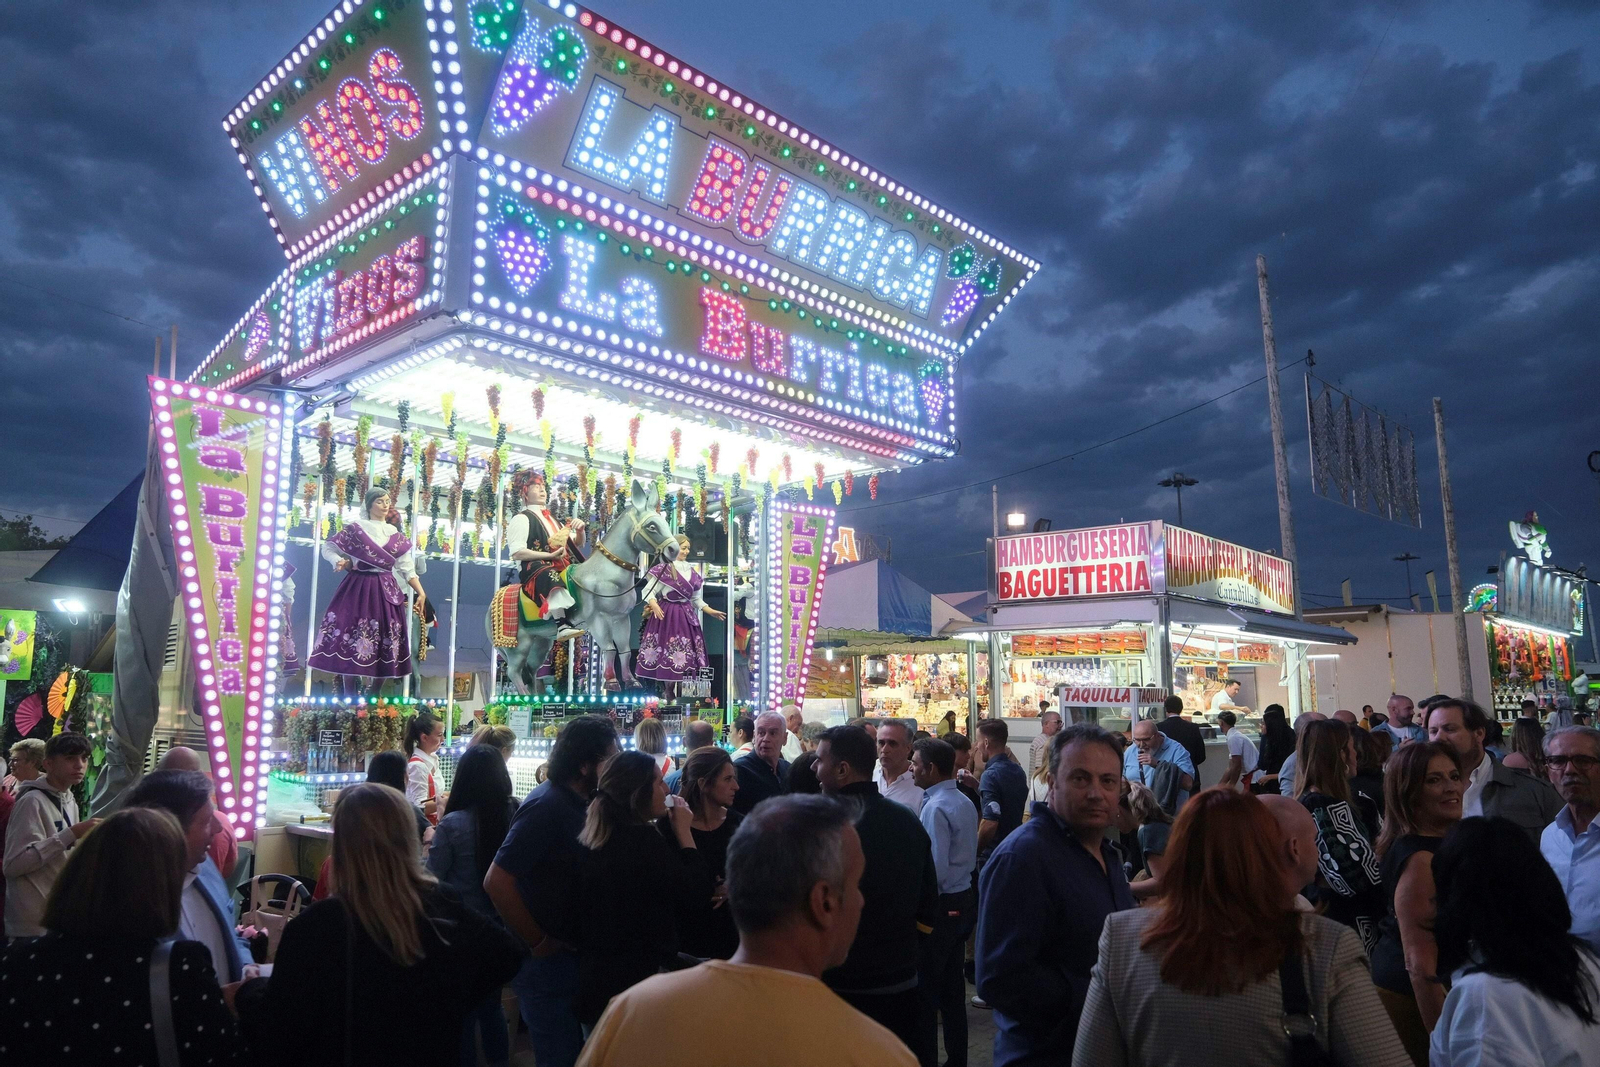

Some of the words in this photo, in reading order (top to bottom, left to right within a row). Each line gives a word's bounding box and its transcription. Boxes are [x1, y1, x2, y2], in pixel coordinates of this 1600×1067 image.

[258, 47, 425, 218] VINOS
[569, 82, 676, 203] LA
[685, 140, 945, 314] BURRICA
[560, 235, 663, 337] La
[701, 287, 919, 418] Burrica
[192, 404, 249, 474] La
[790, 514, 818, 557] La
[998, 525, 1149, 567] HAMBURGUESERIA
[197, 482, 249, 695] Burrica
[999, 560, 1151, 600] BAGUETTERIA
[784, 564, 813, 700] Burrica
[1064, 687, 1131, 704] TAQUILLA
[1138, 688, 1168, 704] TAQUILLA
